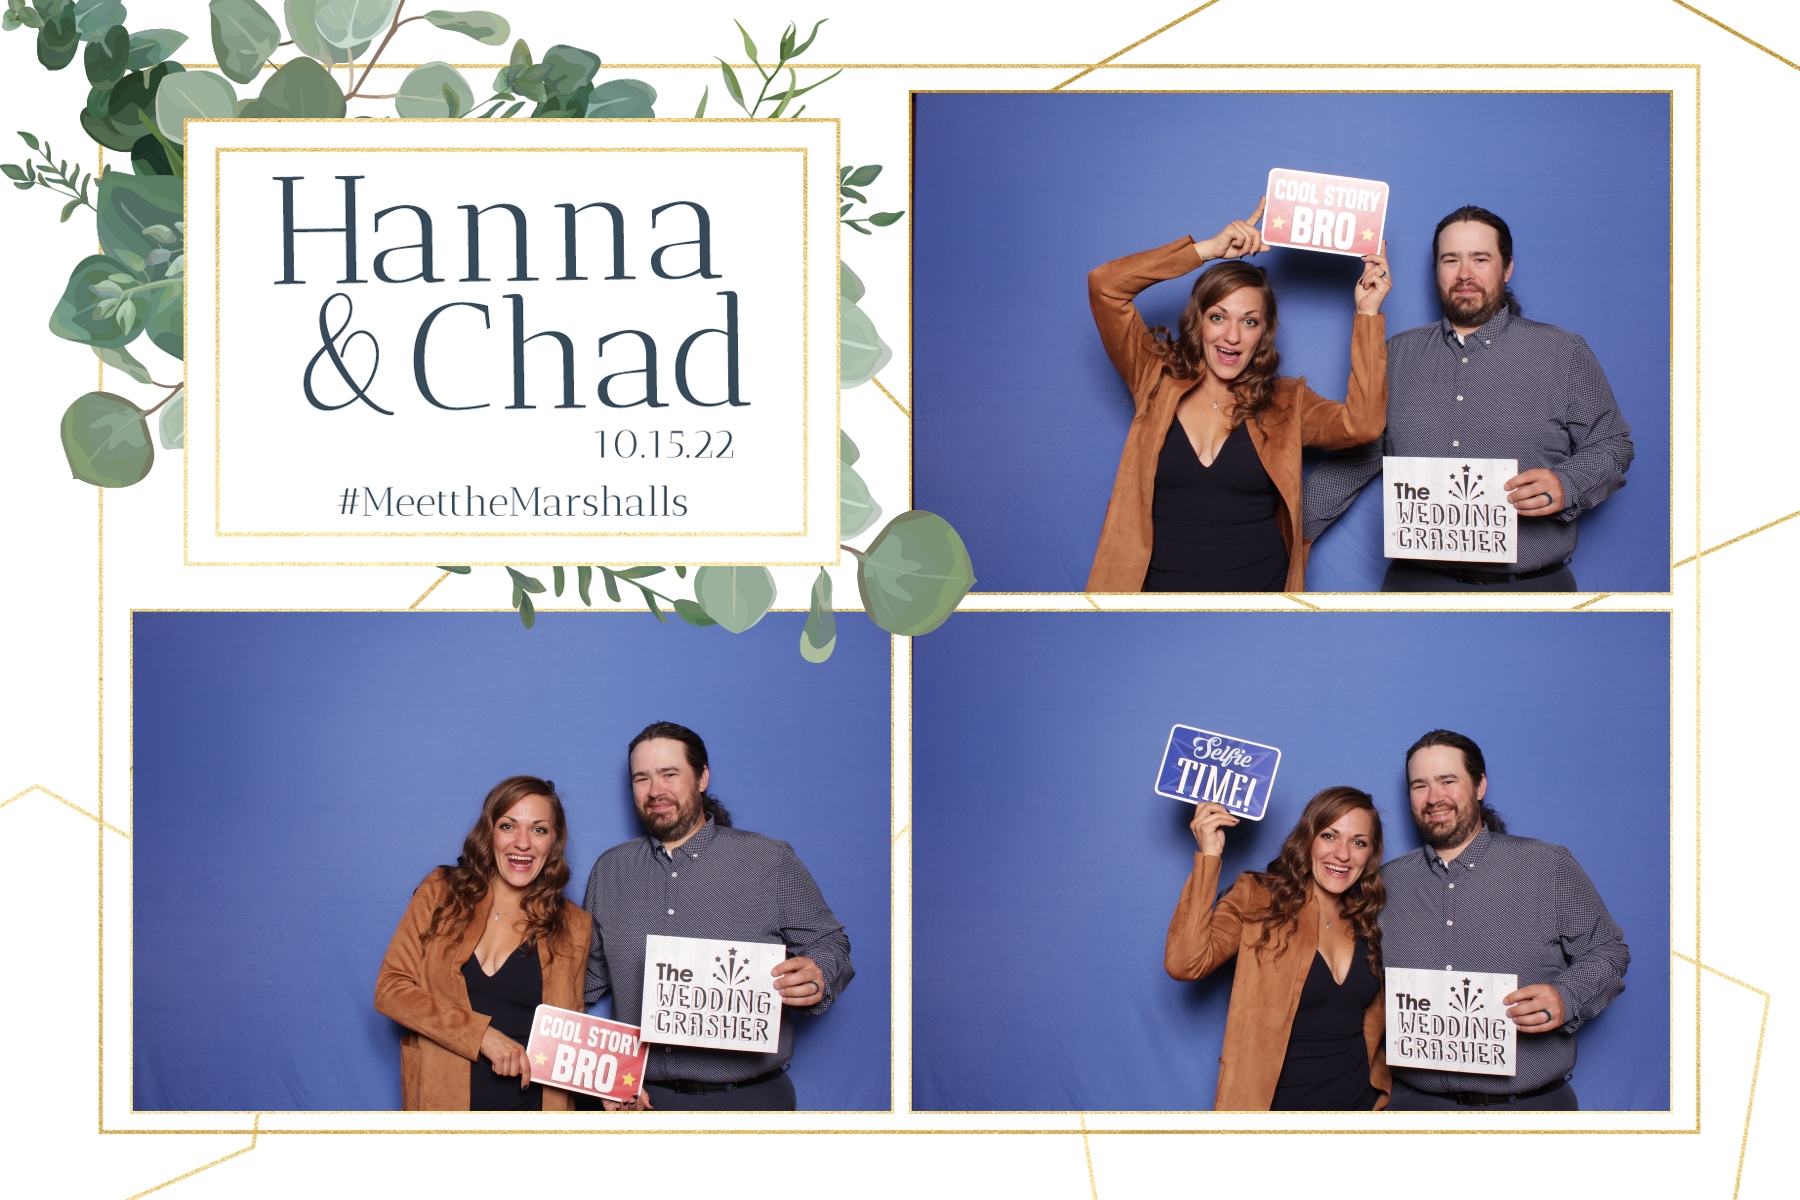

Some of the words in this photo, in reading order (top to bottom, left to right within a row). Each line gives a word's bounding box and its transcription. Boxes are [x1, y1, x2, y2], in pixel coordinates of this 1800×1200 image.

[1274, 178, 1319, 205] COOL
[1323, 184, 1382, 213] STORY
[1289, 205, 1357, 251] BRO
[1393, 482, 1431, 500] The
[1396, 501, 1507, 528] WEDDING
[1396, 526, 1507, 555] CRASHER
[1192, 736, 1253, 768] Selfie
[1175, 757, 1258, 813] TIME!
[655, 962, 693, 983] The
[656, 982, 771, 1016] WEDDING
[1395, 992, 1431, 1011] The
[539, 1014, 583, 1045] COOL
[586, 1025, 643, 1058] STORY
[654, 1009, 769, 1045] CRASHER
[1397, 1011, 1506, 1041] WEDDING
[1397, 1036, 1506, 1068] CRASHER
[550, 1043, 618, 1094] BRO
